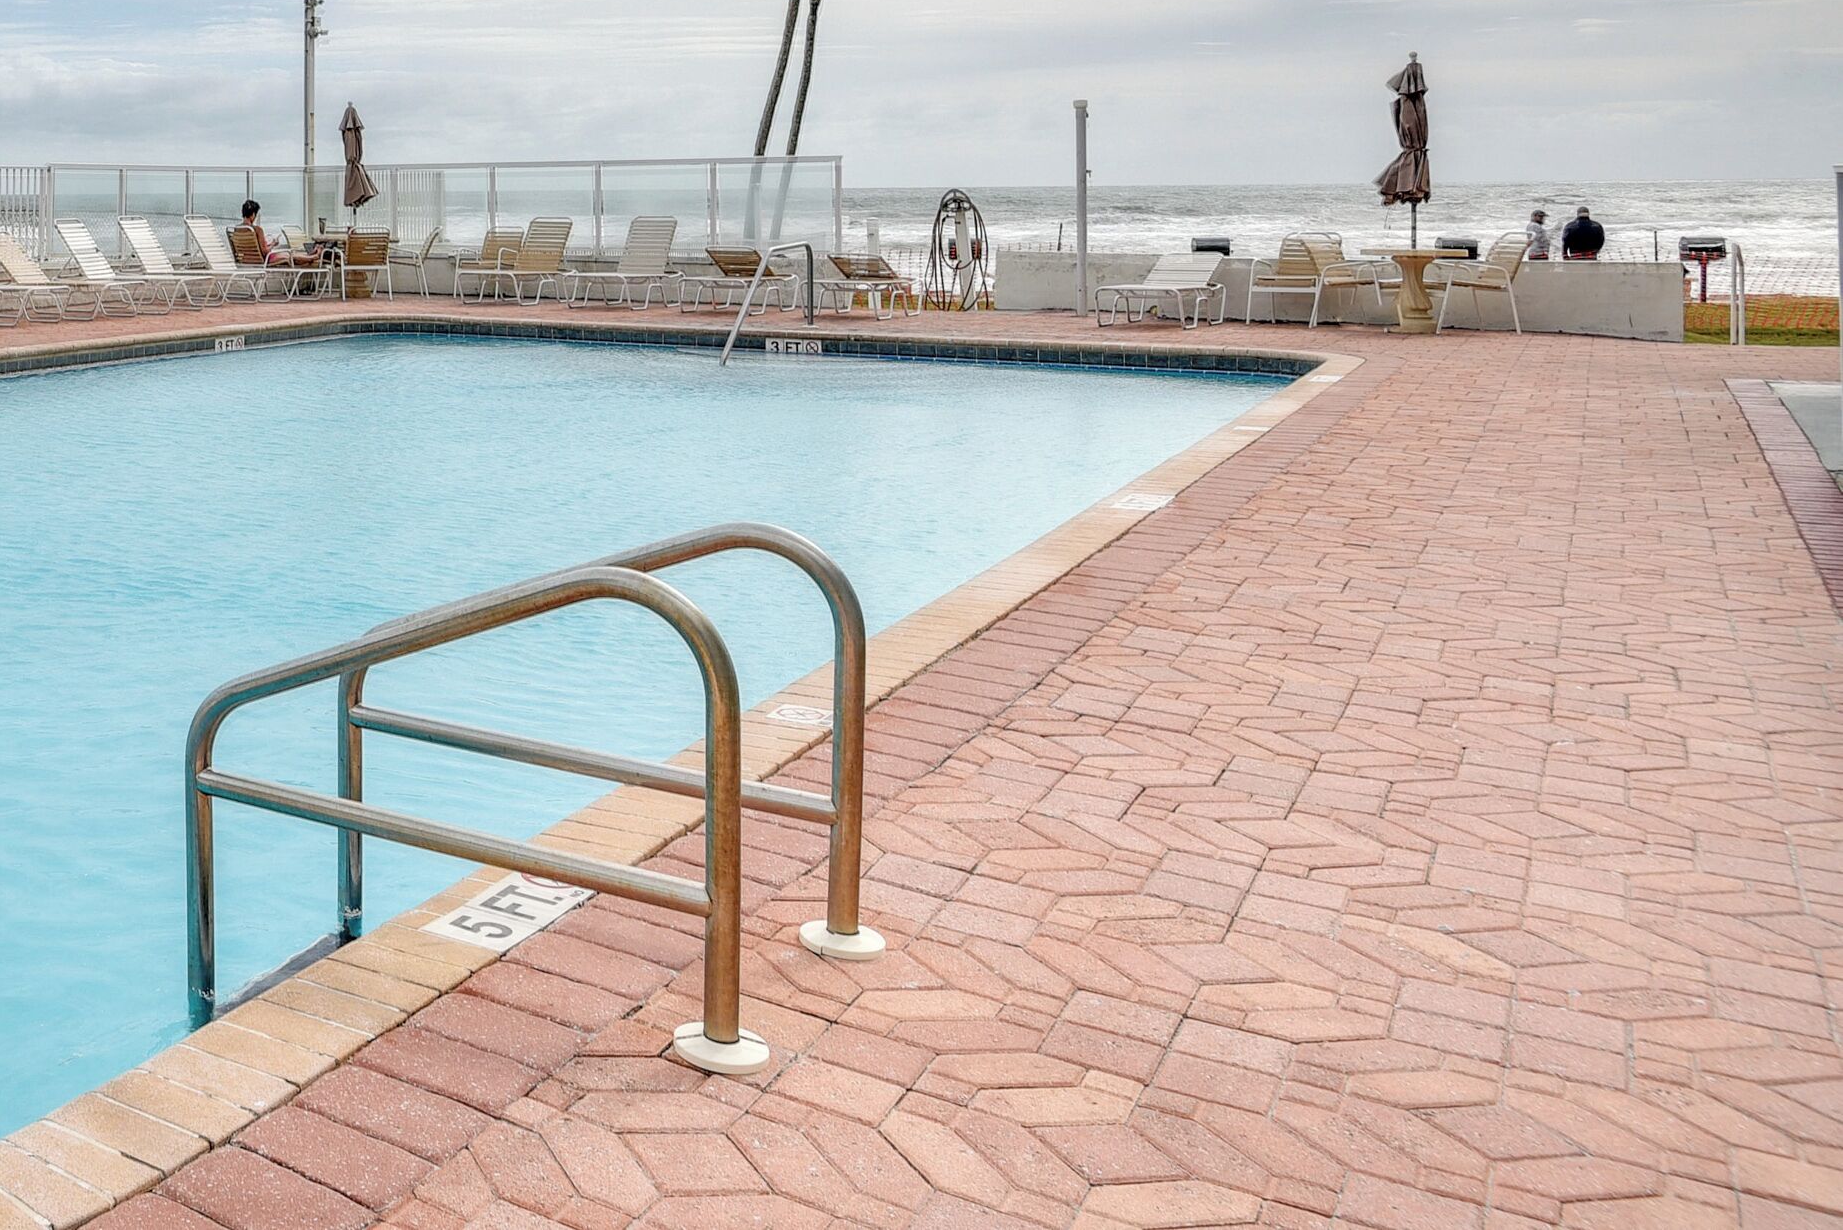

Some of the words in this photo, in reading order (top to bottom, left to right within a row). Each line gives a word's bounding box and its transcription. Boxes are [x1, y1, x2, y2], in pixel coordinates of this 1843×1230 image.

[225, 339, 235, 350] FT
[770, 341, 779, 353] 3
[785, 342, 802, 353] FT
[480, 884, 565, 921] FT.
[449, 915, 513, 939] 5
